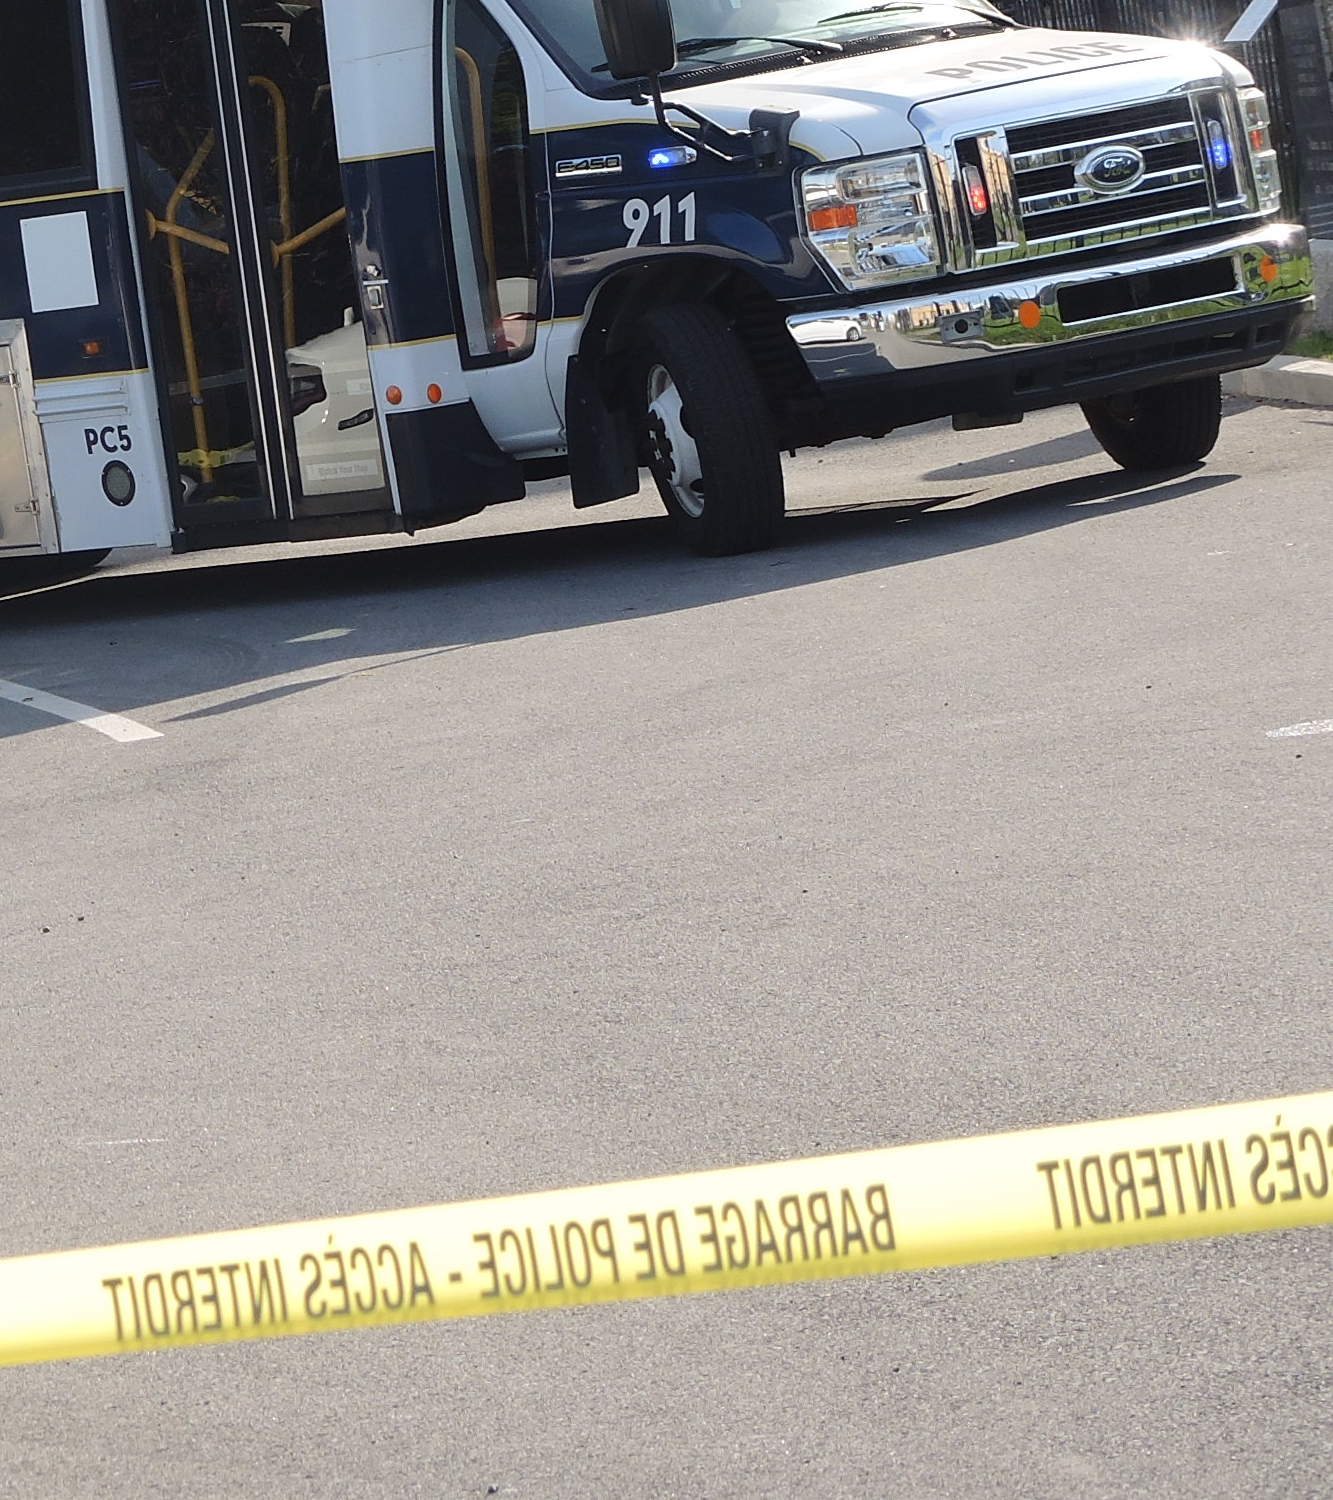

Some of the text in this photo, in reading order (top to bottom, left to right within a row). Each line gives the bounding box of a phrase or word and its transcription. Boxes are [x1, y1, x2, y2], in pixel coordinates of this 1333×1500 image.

[925, 41, 1144, 83] POLICE
[623, 191, 696, 249] 911
[84, 425, 132, 454] PC5
